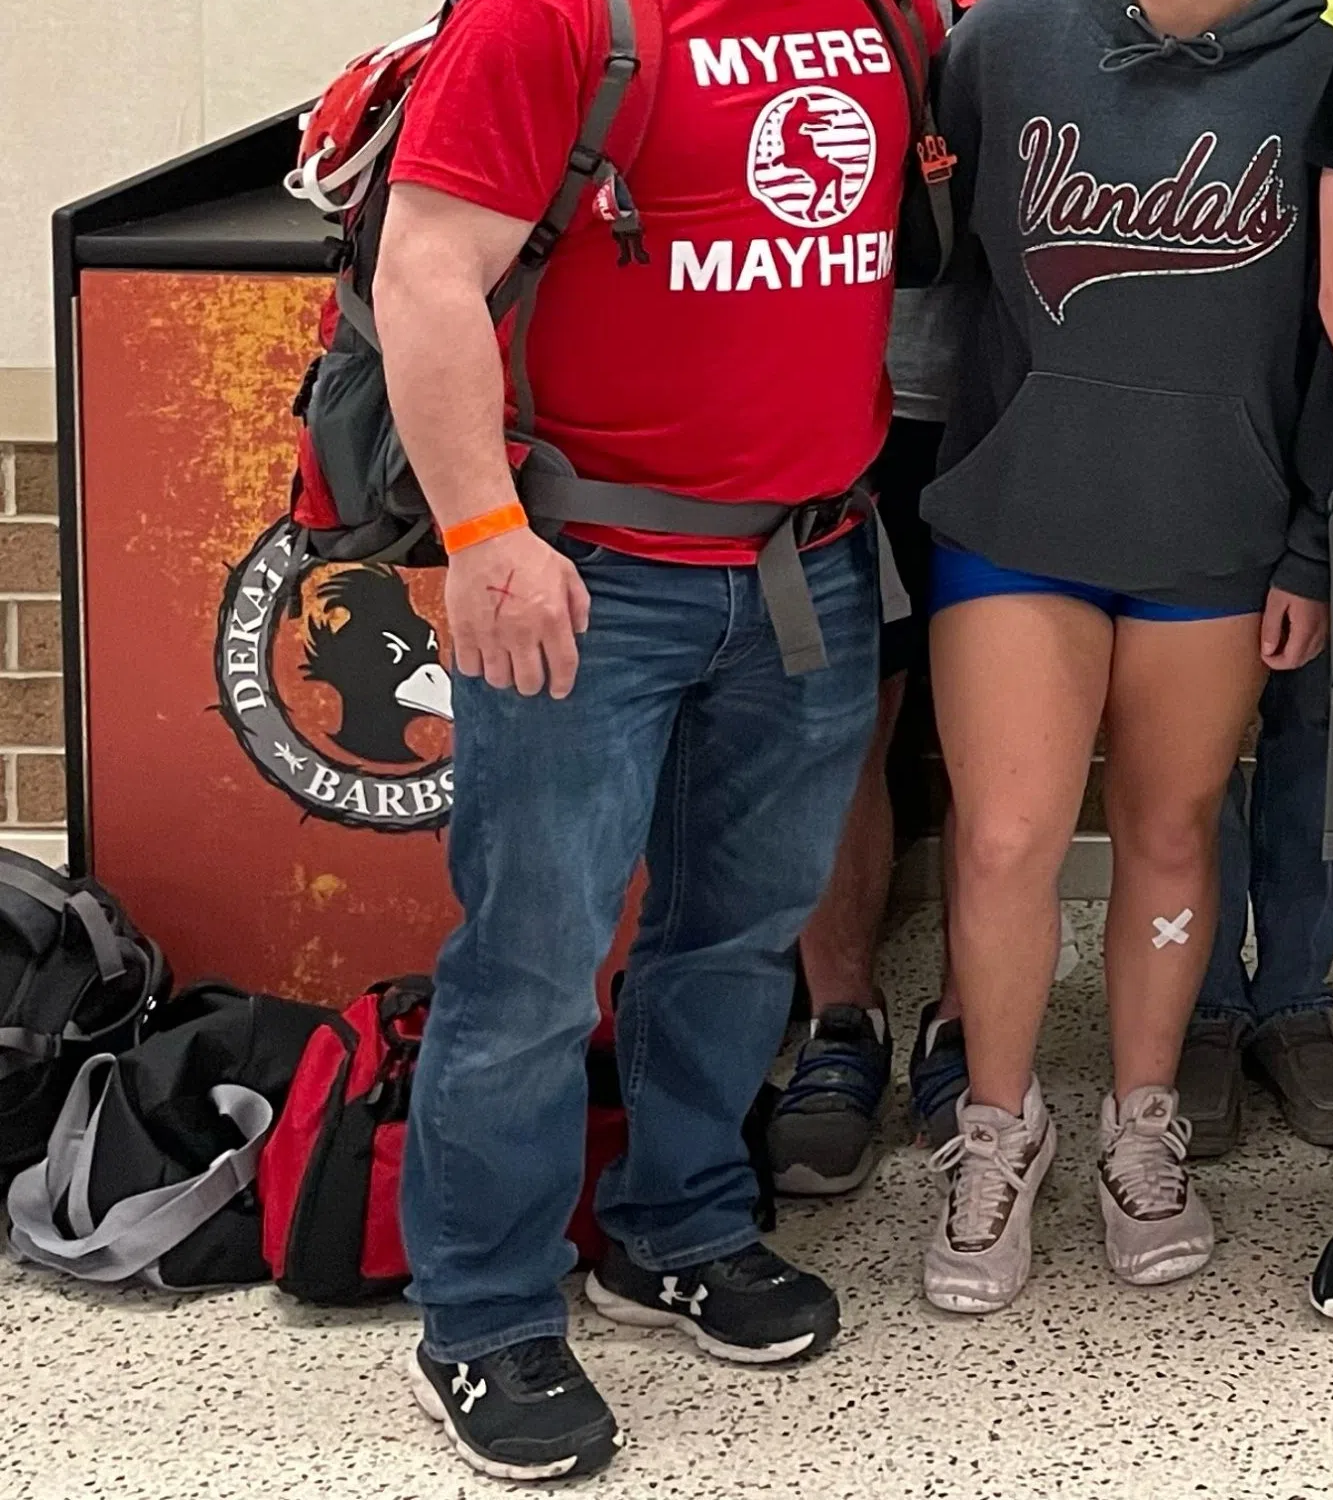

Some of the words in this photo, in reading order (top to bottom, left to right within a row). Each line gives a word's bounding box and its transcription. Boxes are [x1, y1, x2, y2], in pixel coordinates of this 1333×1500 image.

[687, 26, 891, 87] MYERS
[1018, 115, 1298, 249] Vandals
[669, 233, 894, 292] MAYHEM
[304, 762, 454, 817] BARBS
